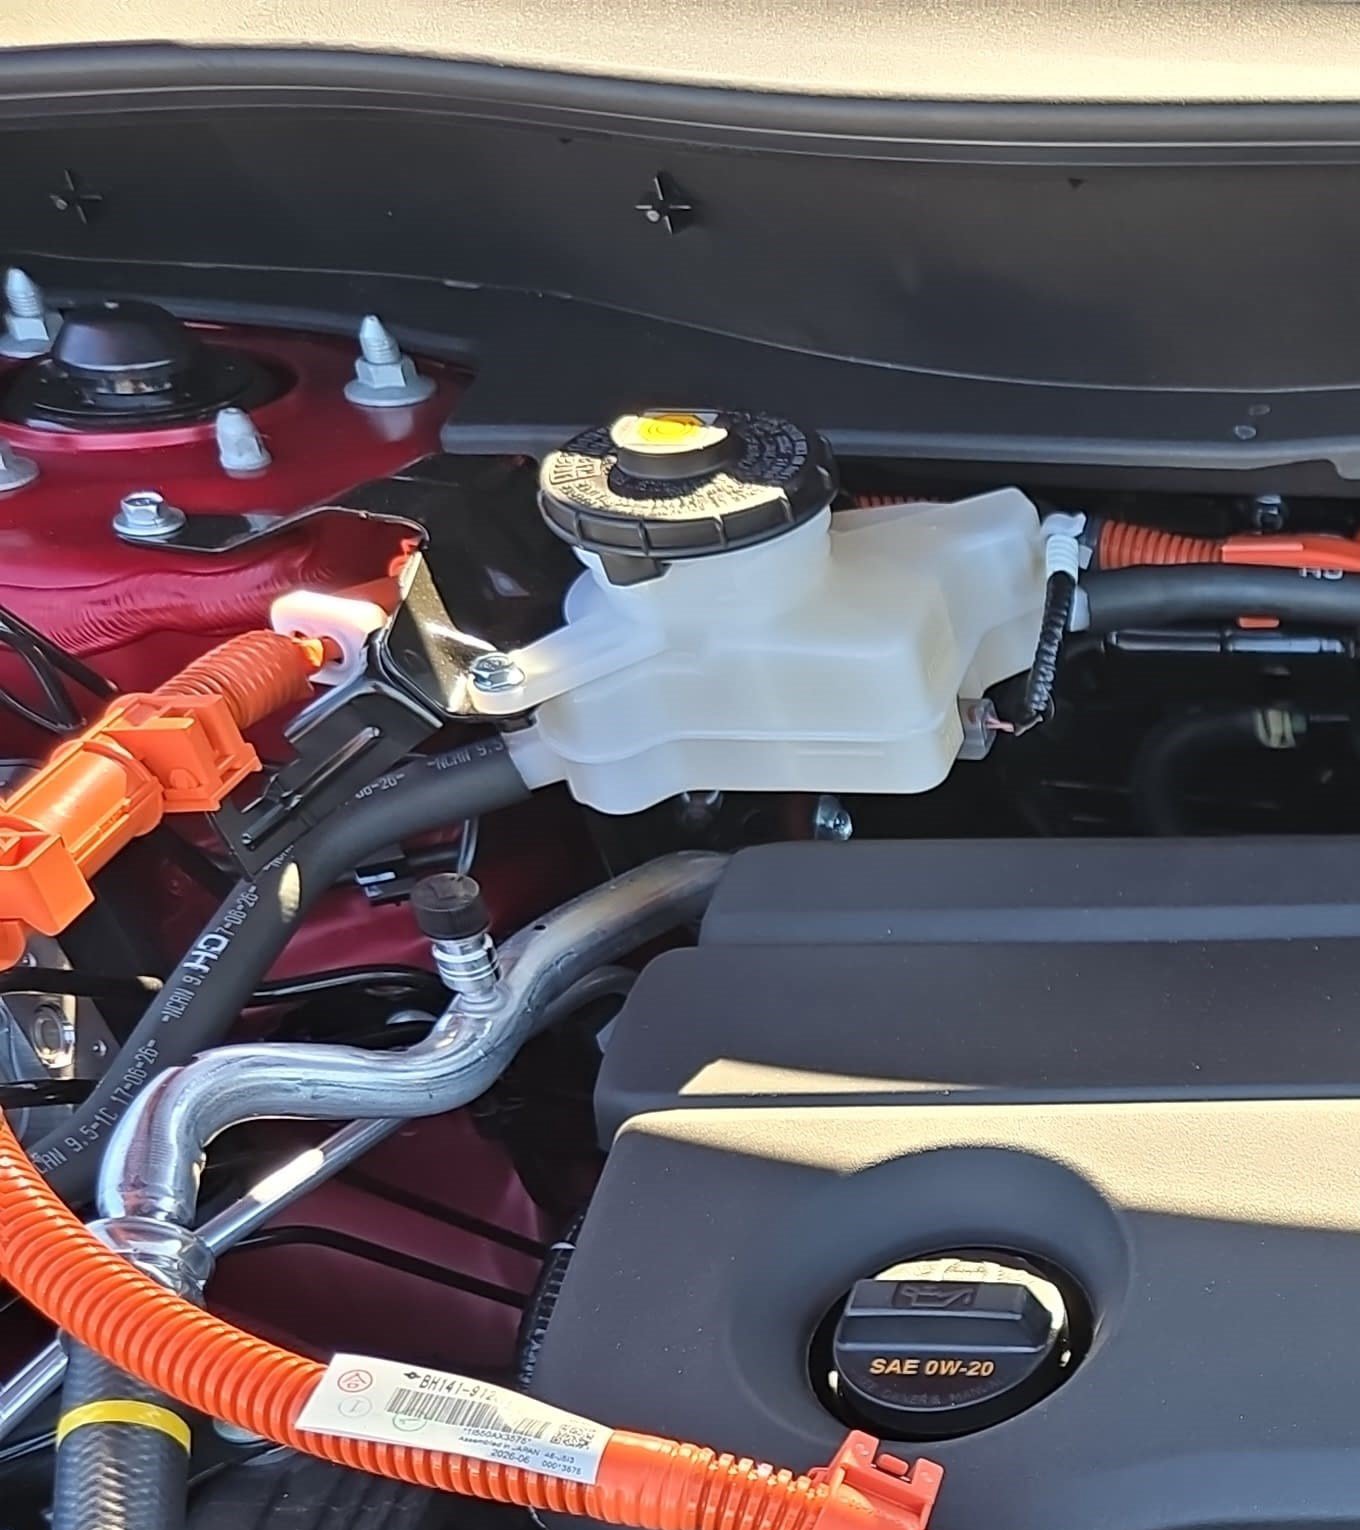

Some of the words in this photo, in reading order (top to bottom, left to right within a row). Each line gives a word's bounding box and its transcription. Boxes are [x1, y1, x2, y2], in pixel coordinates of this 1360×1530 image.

[216, 885, 260, 936] 7-06-26-
[868, 1358, 920, 1375] SAE
[924, 1359, 995, 1377] 0W-20
